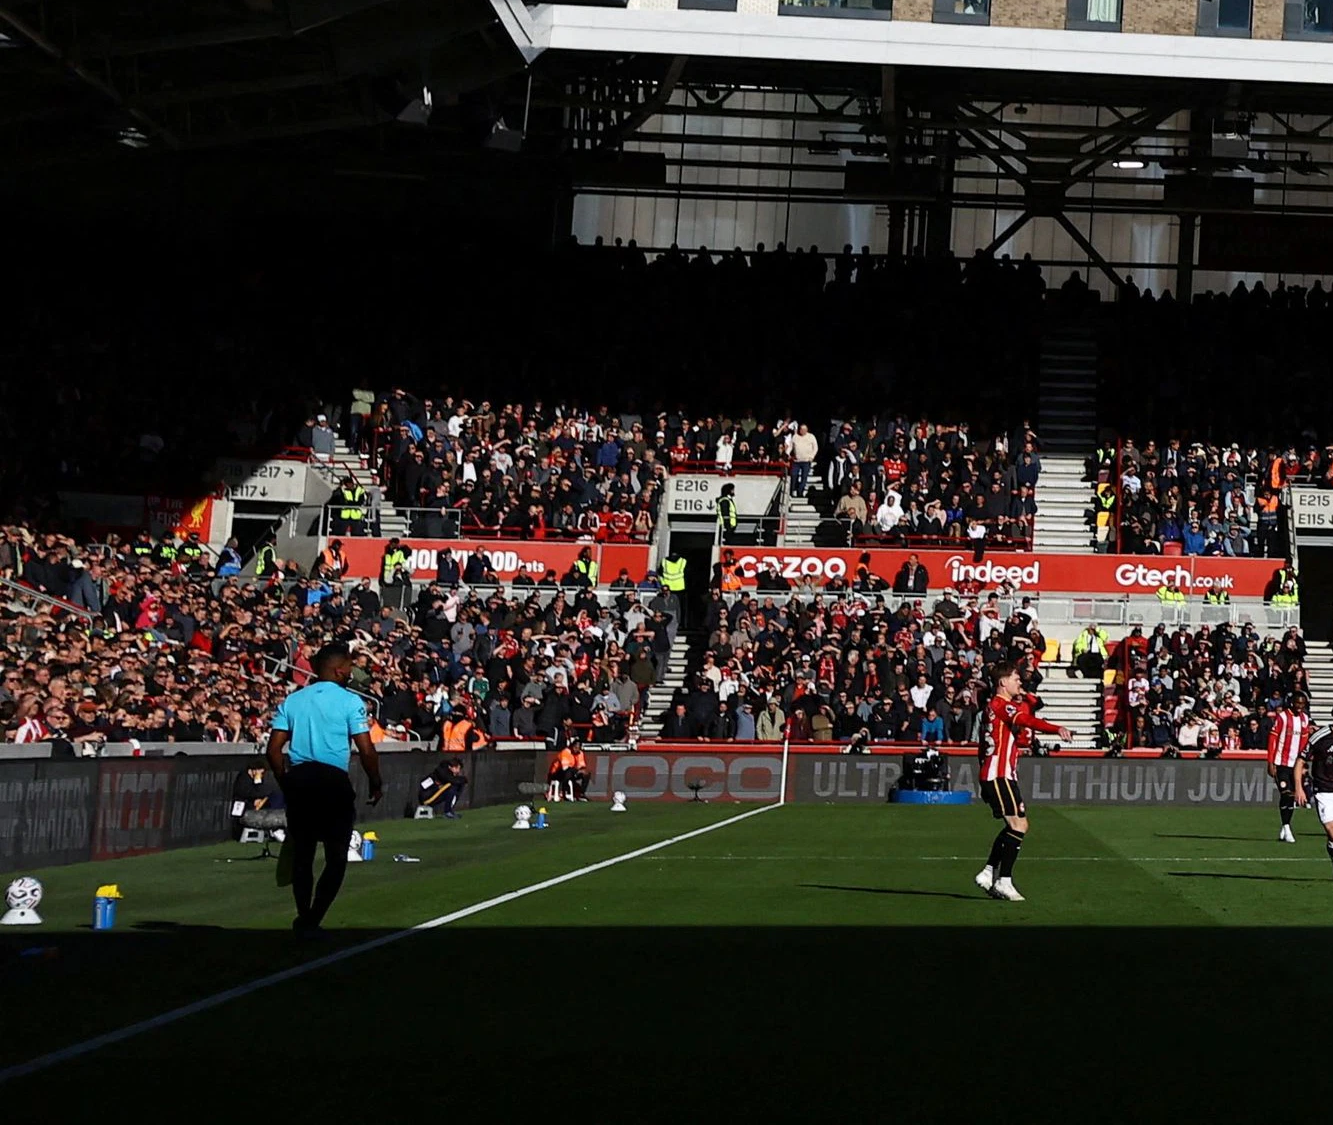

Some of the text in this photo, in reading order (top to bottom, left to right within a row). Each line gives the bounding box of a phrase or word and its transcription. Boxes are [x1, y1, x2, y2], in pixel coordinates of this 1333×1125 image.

[251, 466, 280, 478] E217
[232, 485, 257, 497] E117
[675, 480, 709, 492] E216
[674, 500, 703, 511] E116
[1299, 495, 1330, 506] E215
[1298, 514, 1325, 525] E115
[945, 556, 1040, 584] indeed
[1032, 764, 1176, 801] LITHIUM
